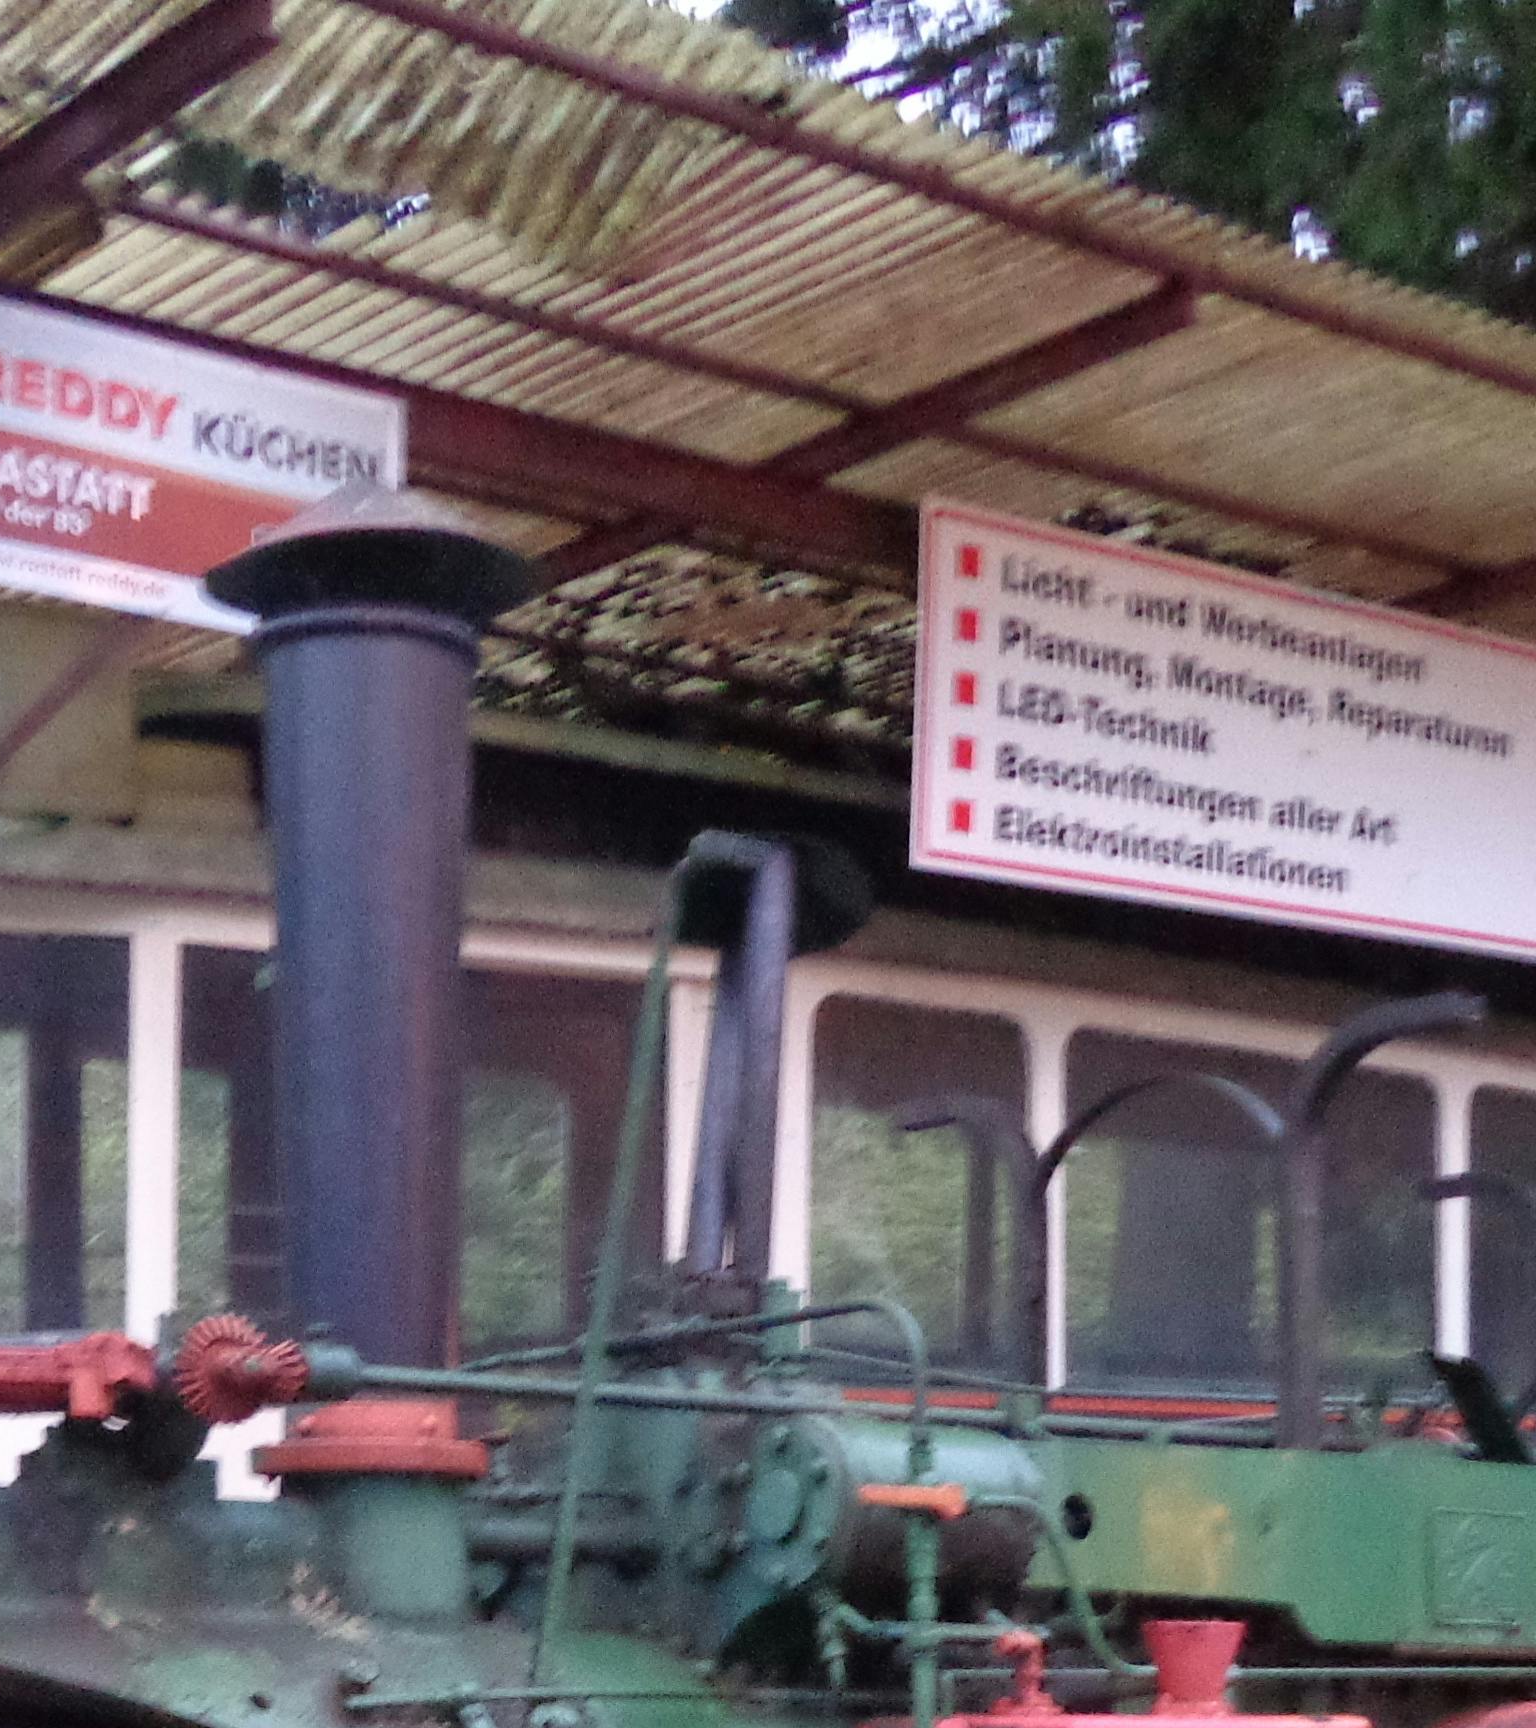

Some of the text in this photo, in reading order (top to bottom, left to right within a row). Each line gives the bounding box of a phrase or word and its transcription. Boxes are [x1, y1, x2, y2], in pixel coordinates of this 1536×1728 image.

[191, 409, 381, 485] KÜCHEN
[4, 500, 54, 529] der
[999, 550, 1092, 606] Licht
[1122, 581, 1189, 630] und
[1199, 600, 1426, 684] Werbeanlagen
[995, 677, 1217, 760] LED-Technik
[997, 617, 1515, 760] Planung, Montage, Reparaturen
[994, 740, 1396, 846] Beschriftungen aller Art
[992, 801, 1351, 895] Elektroinstallationen
